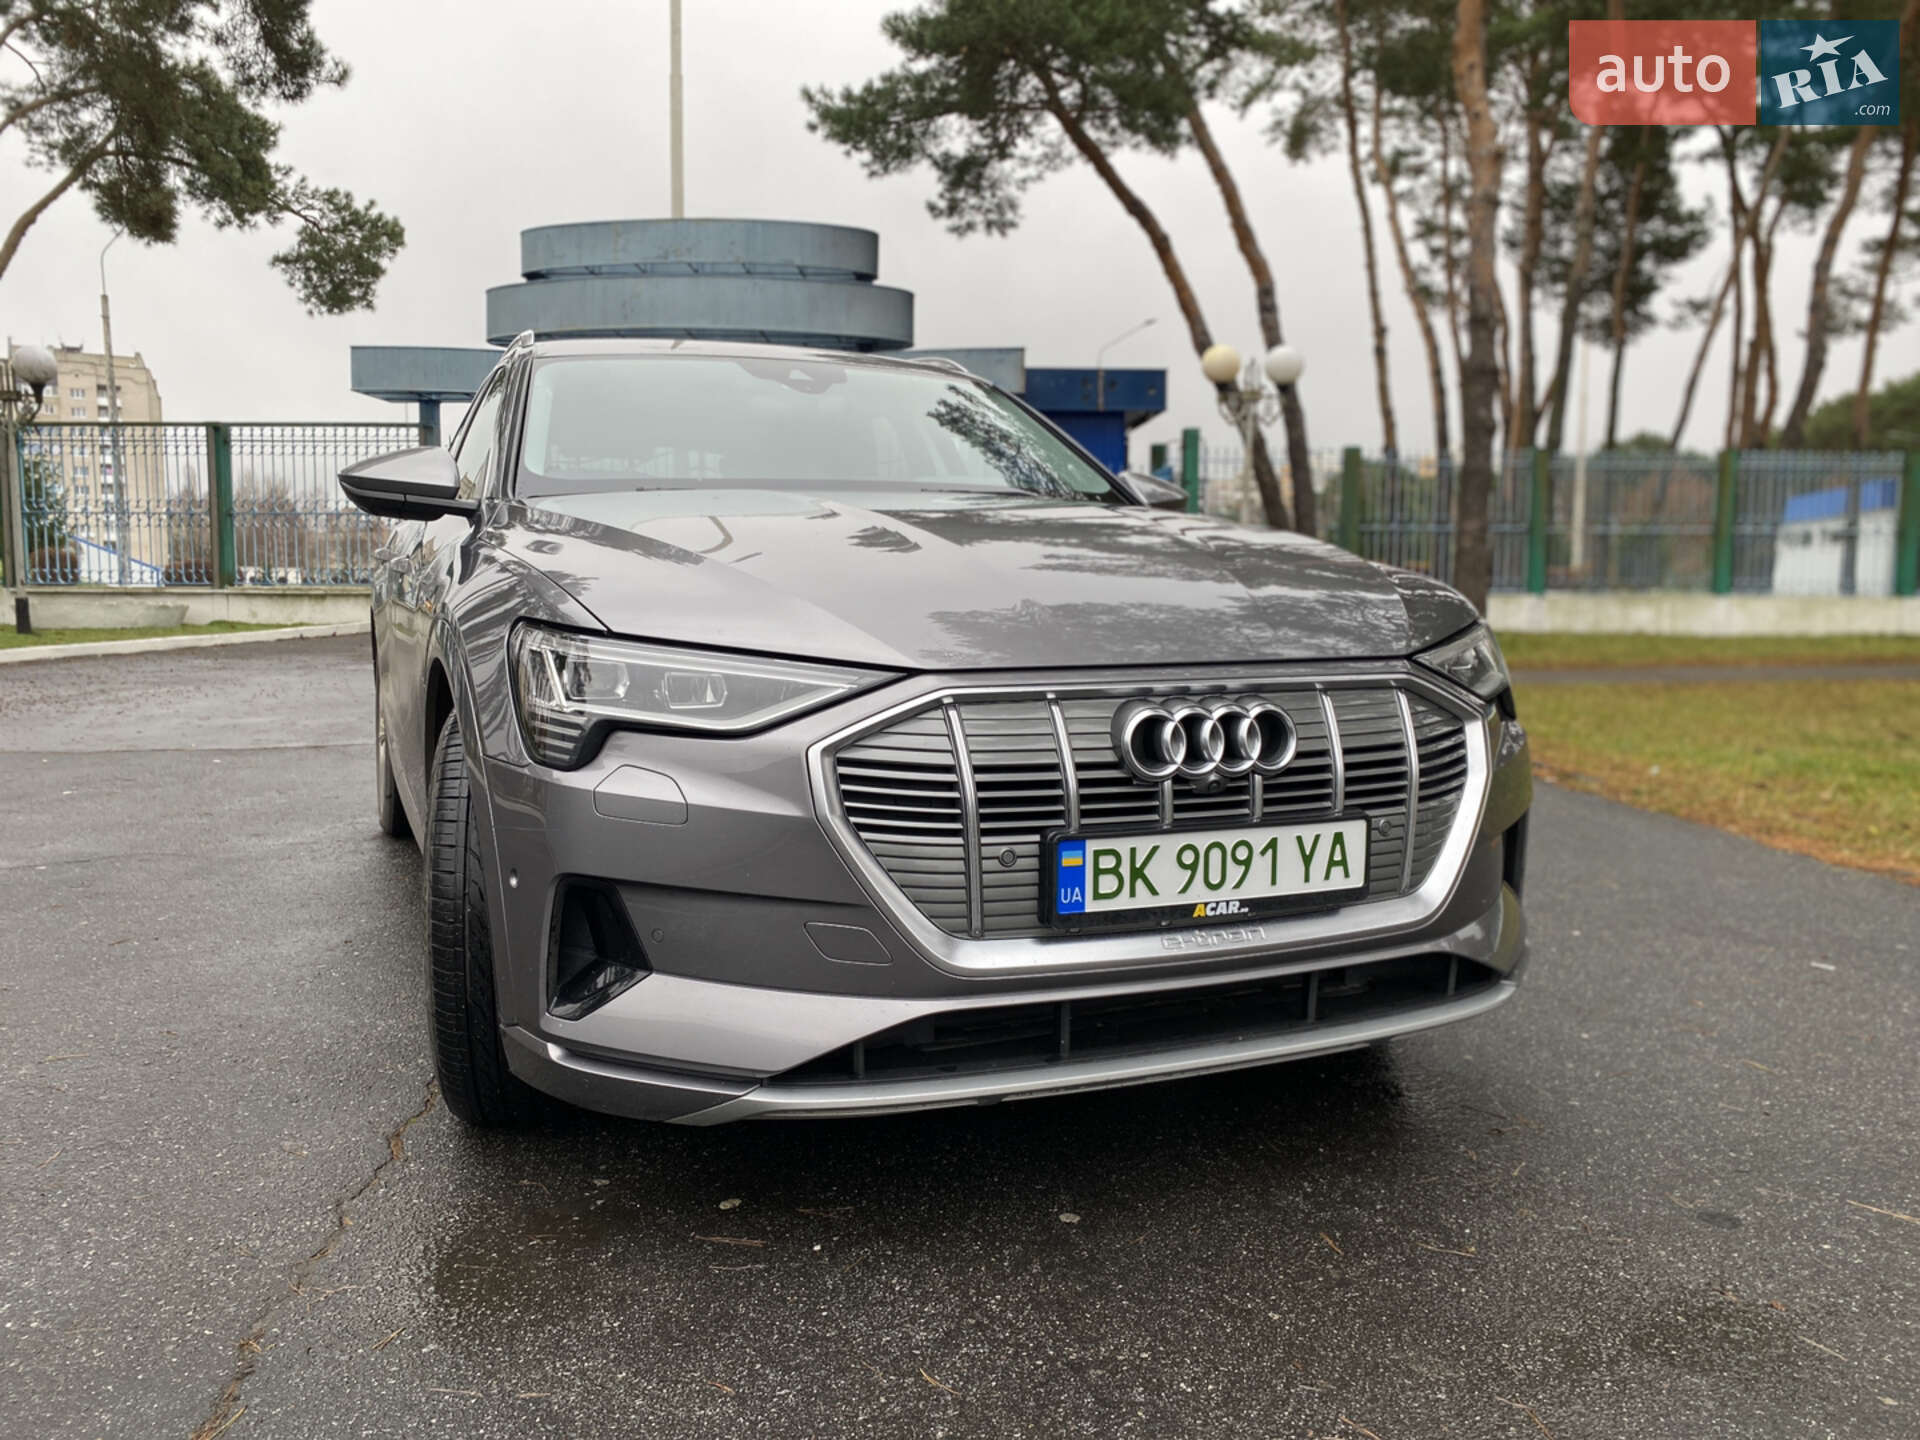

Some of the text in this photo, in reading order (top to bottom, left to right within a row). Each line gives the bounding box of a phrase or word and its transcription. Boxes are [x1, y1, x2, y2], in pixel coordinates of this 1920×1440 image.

[1092, 831, 1351, 901] BK 9091 YA
[1060, 887, 1083, 905] UA
